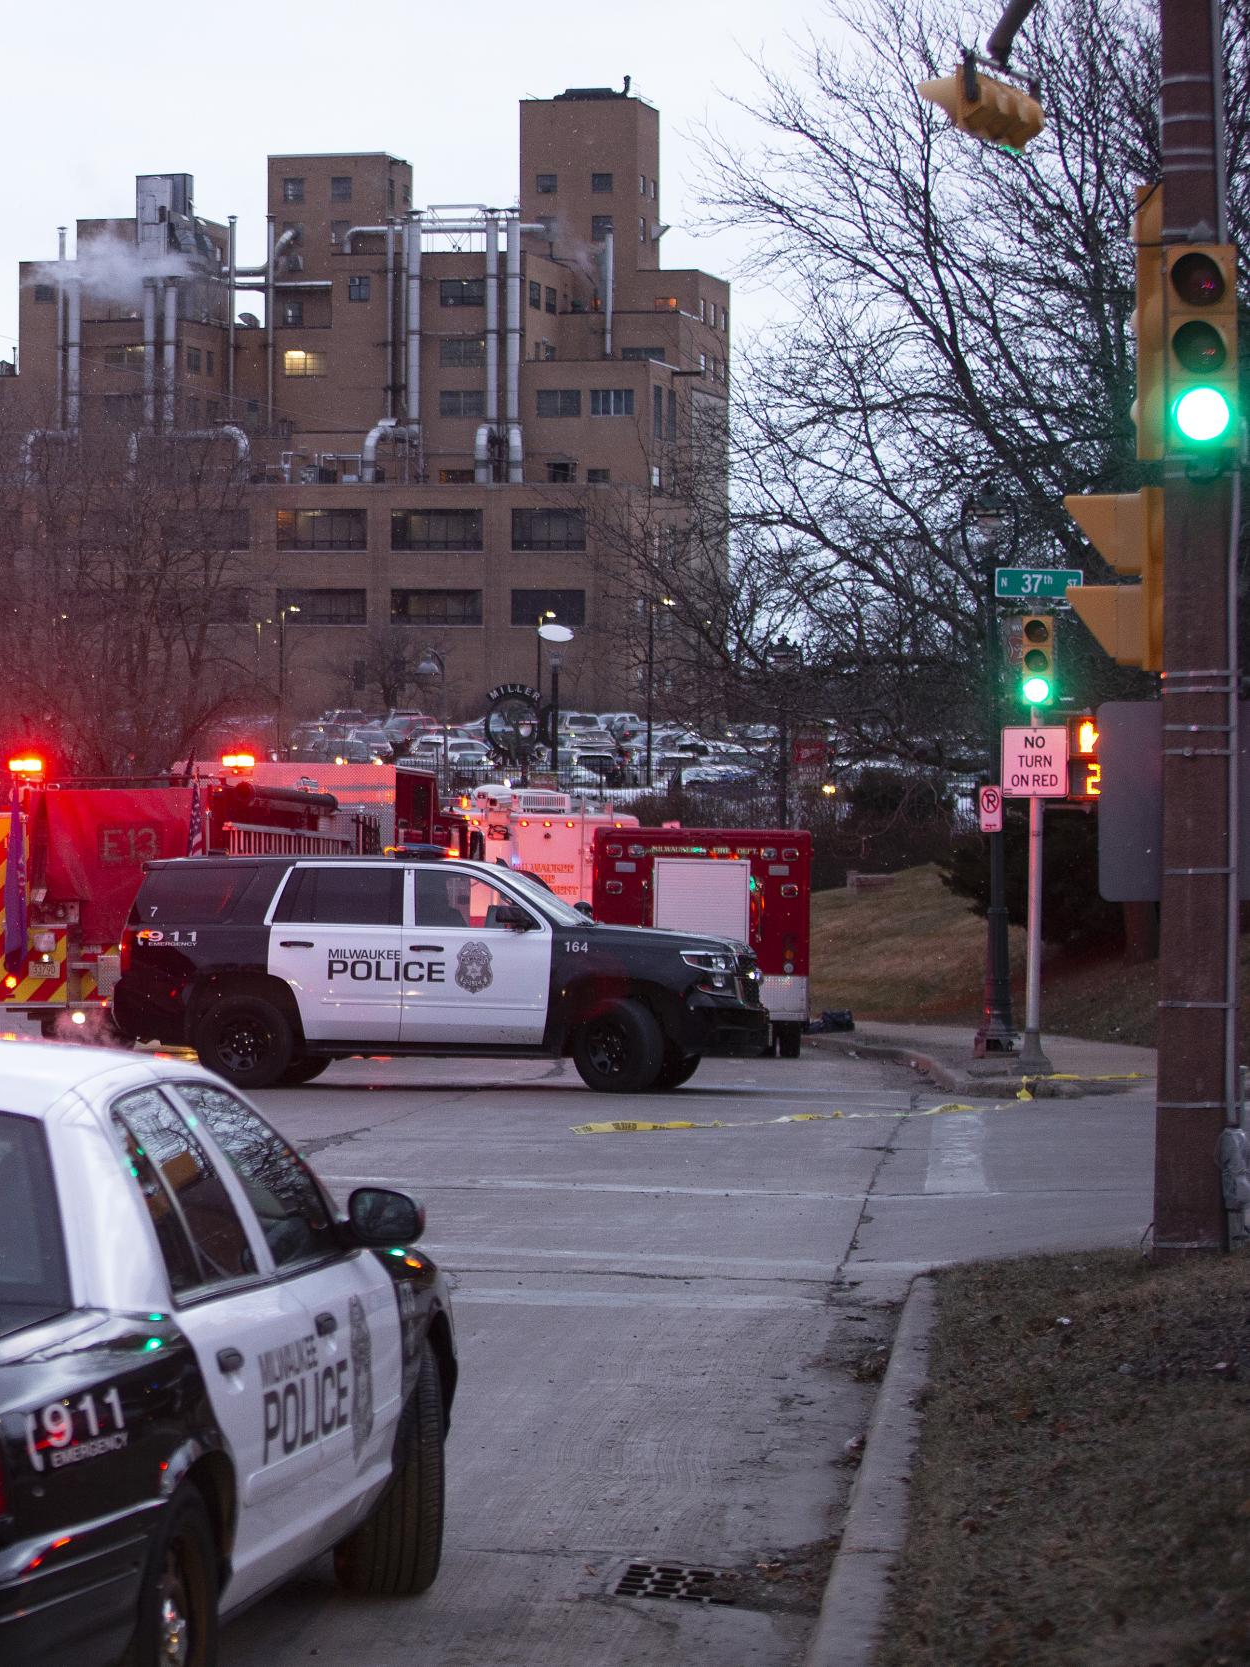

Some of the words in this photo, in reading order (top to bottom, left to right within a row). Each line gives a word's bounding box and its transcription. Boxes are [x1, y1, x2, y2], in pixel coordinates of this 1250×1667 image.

[1001, 577, 1008, 587] N
[1021, 574, 1053, 594] 37th
[1067, 579, 1078, 588] ST
[489, 684, 541, 701] MILLER
[1024, 736, 1046, 749] NO
[1019, 756, 1052, 768] TURN
[1011, 775, 1029, 787] ON
[1032, 775, 1058, 787] RED
[102, 828, 159, 864] E13
[150, 906, 158, 918] 7
[147, 930, 197, 942] 911
[328, 949, 400, 960] MILWAUKEE
[565, 941, 589, 953] 164
[327, 960, 445, 983] POLICE
[257, 1334, 319, 1389] MILWAUKEE
[42, 1386, 126, 1448] 911
[263, 1358, 349, 1466] POLICE
[51, 1431, 128, 1468] EMERGENCY
